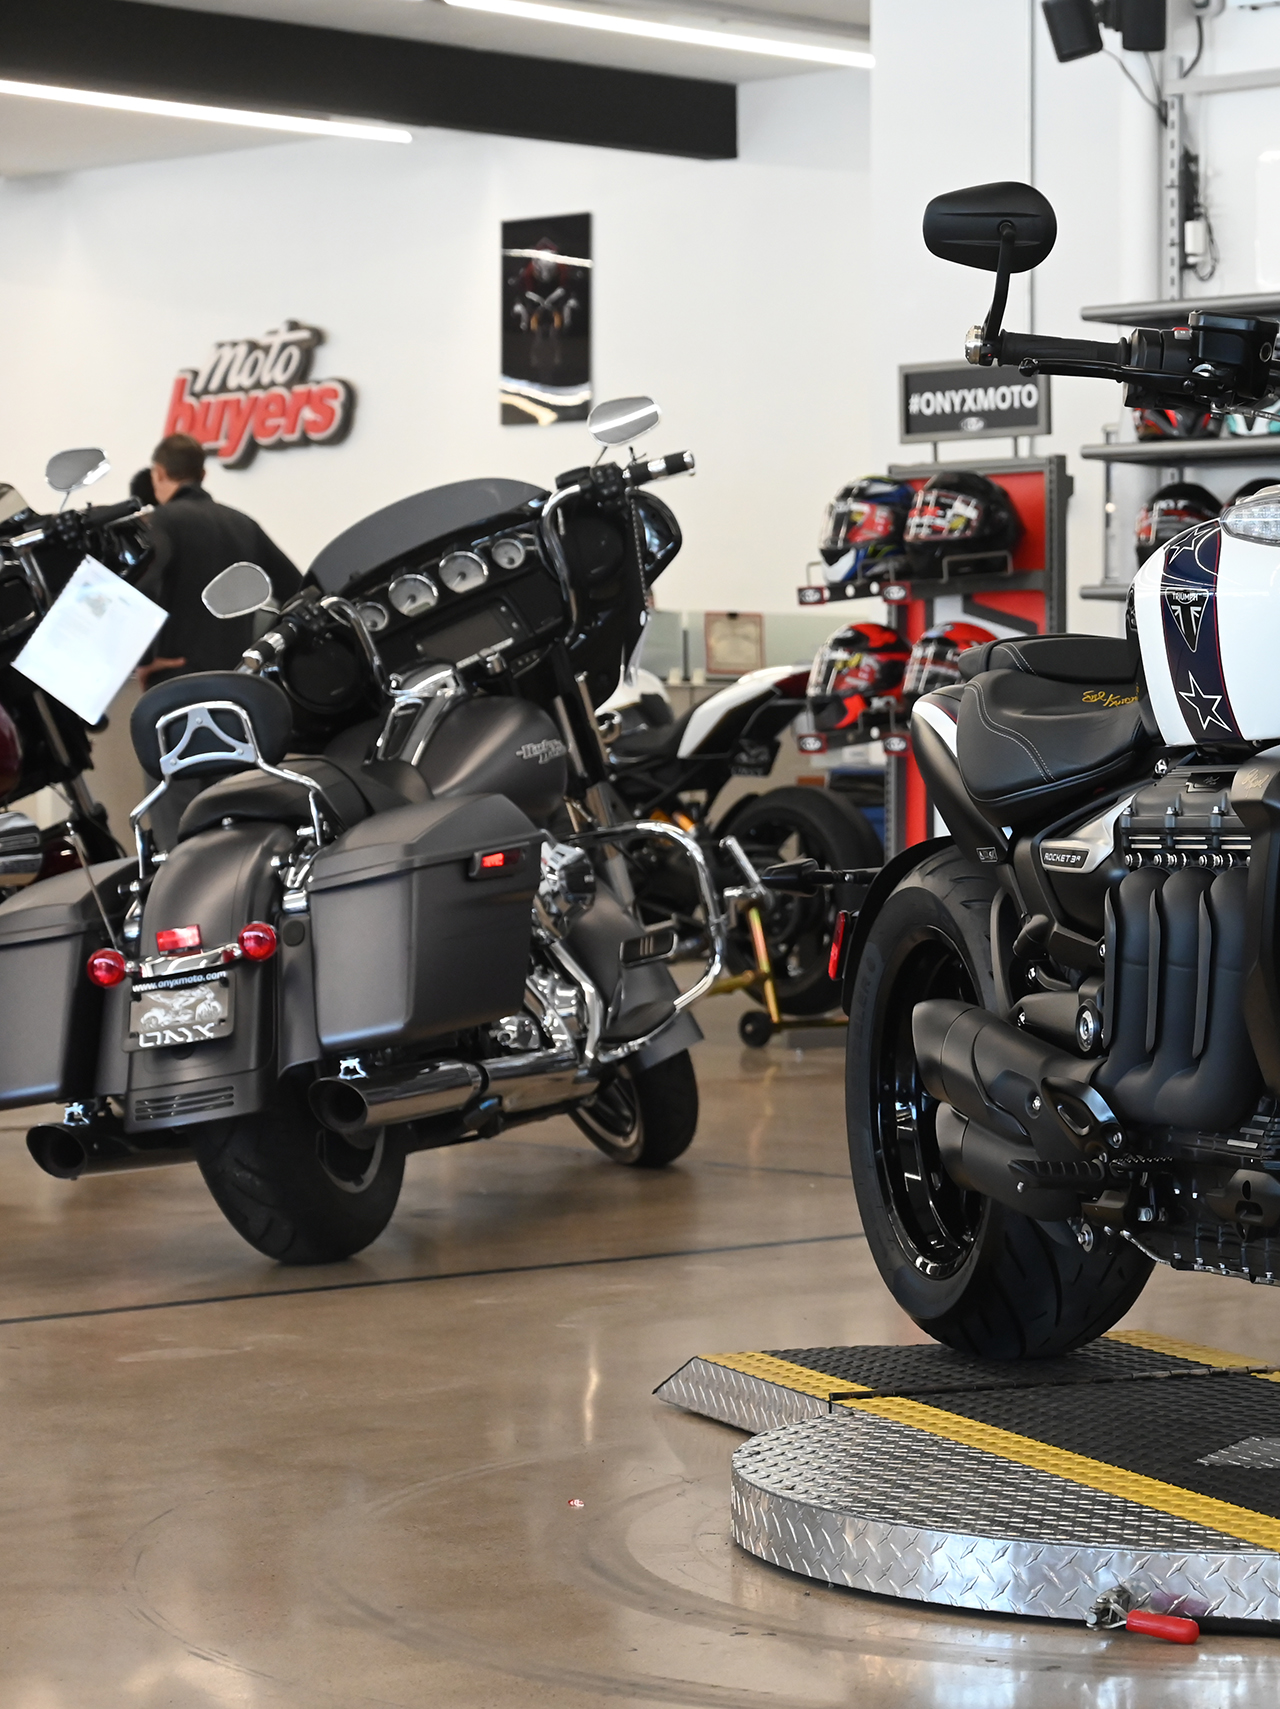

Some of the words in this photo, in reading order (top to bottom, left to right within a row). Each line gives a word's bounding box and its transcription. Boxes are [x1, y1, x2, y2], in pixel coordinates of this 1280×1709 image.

[908, 383, 1039, 416] #ONYXMOTO
[163, 375, 345, 460] buyers
[132, 971, 227, 993] www.onyxmoto.com
